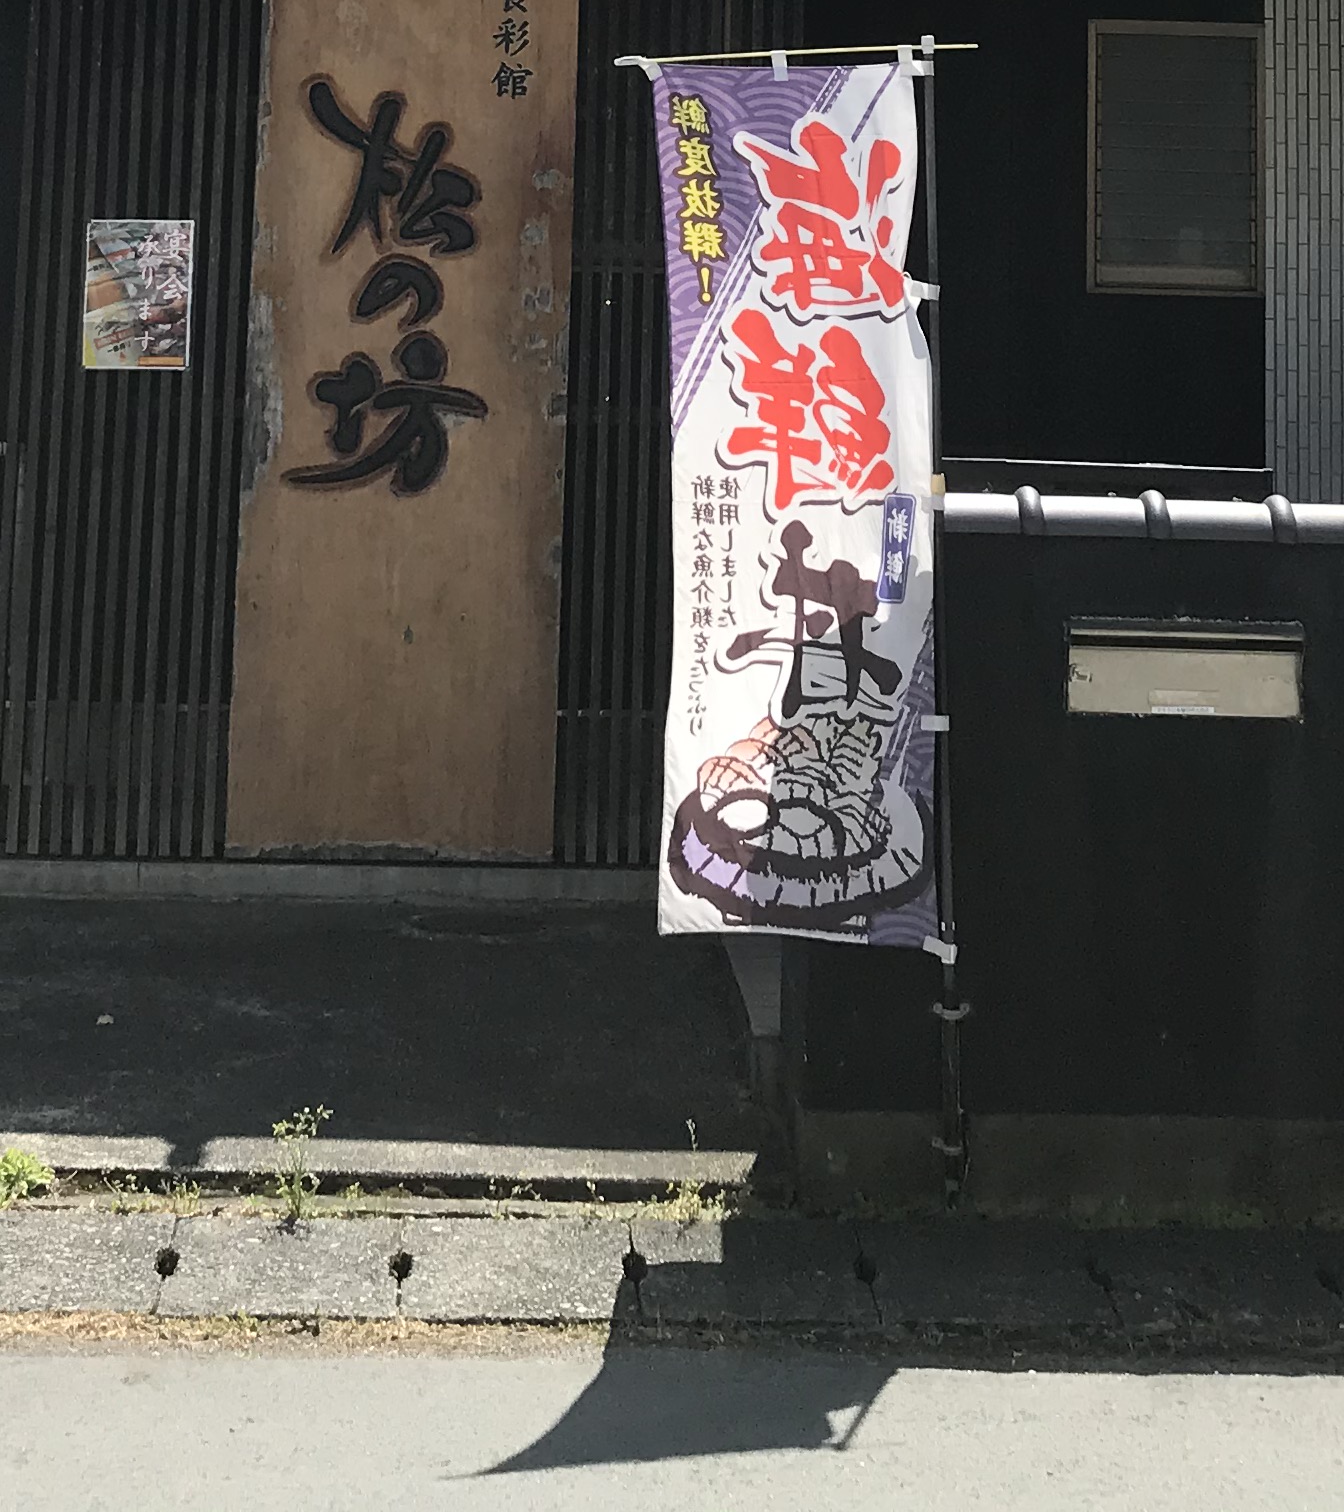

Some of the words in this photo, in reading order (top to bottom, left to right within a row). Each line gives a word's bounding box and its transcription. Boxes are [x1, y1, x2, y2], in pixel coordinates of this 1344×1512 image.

[134, 235, 161, 352] 承ります
[157, 228, 191, 300] 宴会
[280, 74, 488, 496] 松の坊
